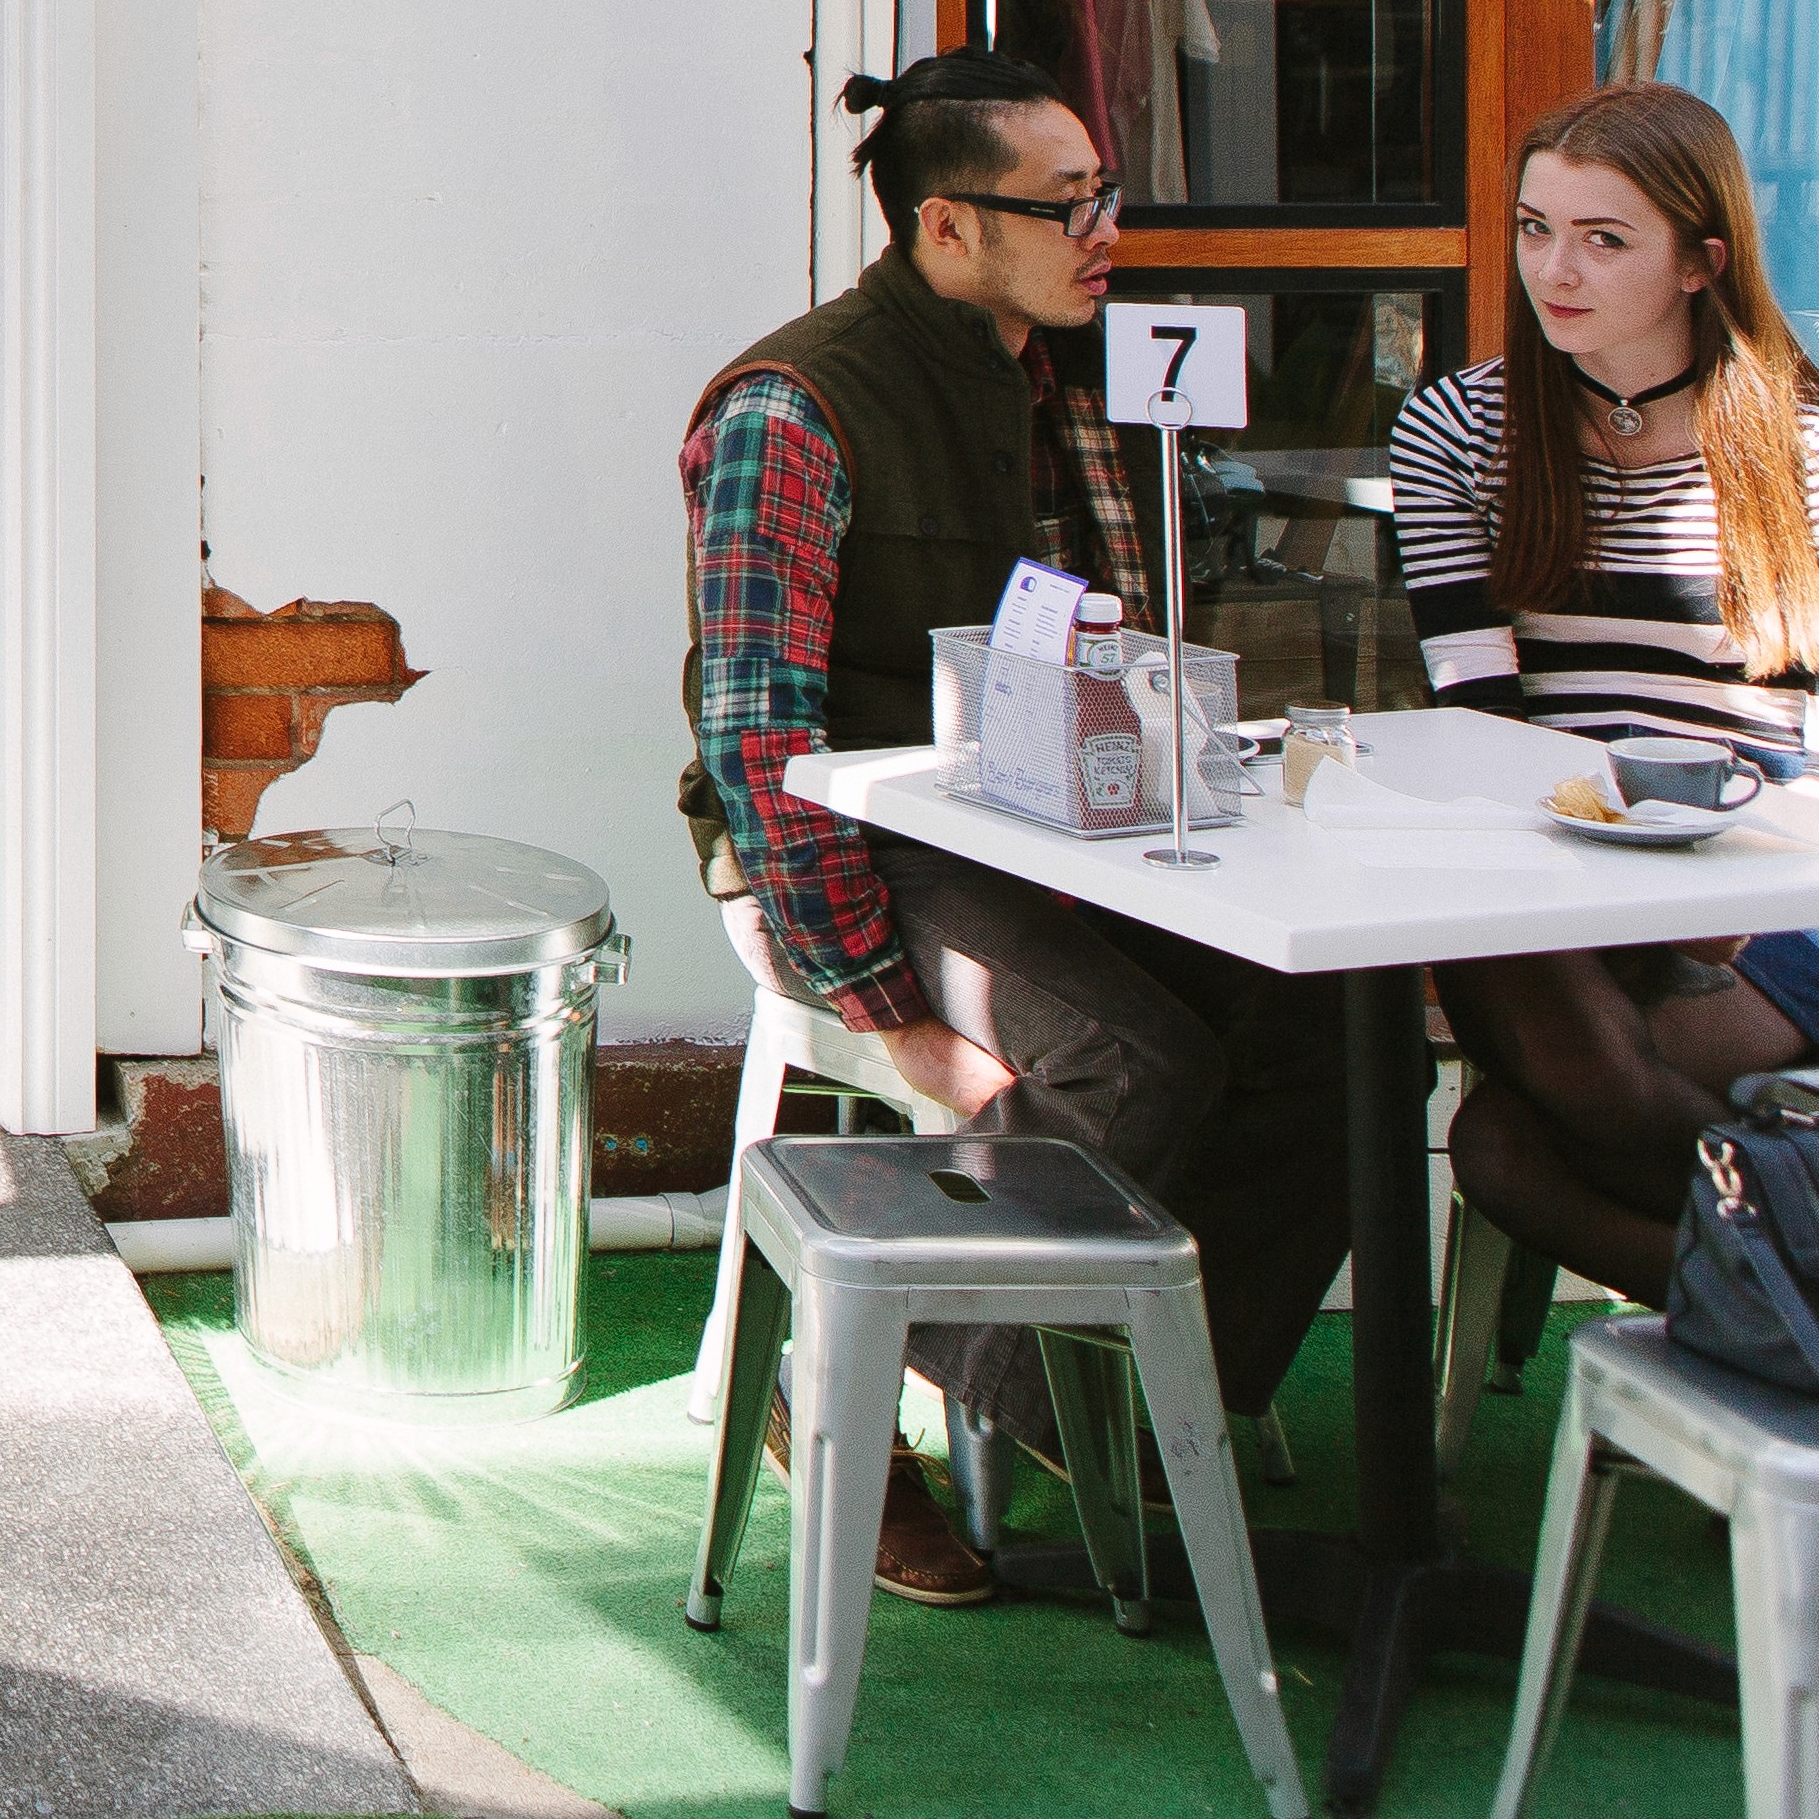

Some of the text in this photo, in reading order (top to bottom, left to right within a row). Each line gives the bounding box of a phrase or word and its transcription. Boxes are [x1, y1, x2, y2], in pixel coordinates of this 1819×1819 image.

[1150, 324, 1197, 403] 7
[1100, 653, 1117, 664] 57
[1095, 740, 1131, 753] HEINZ
